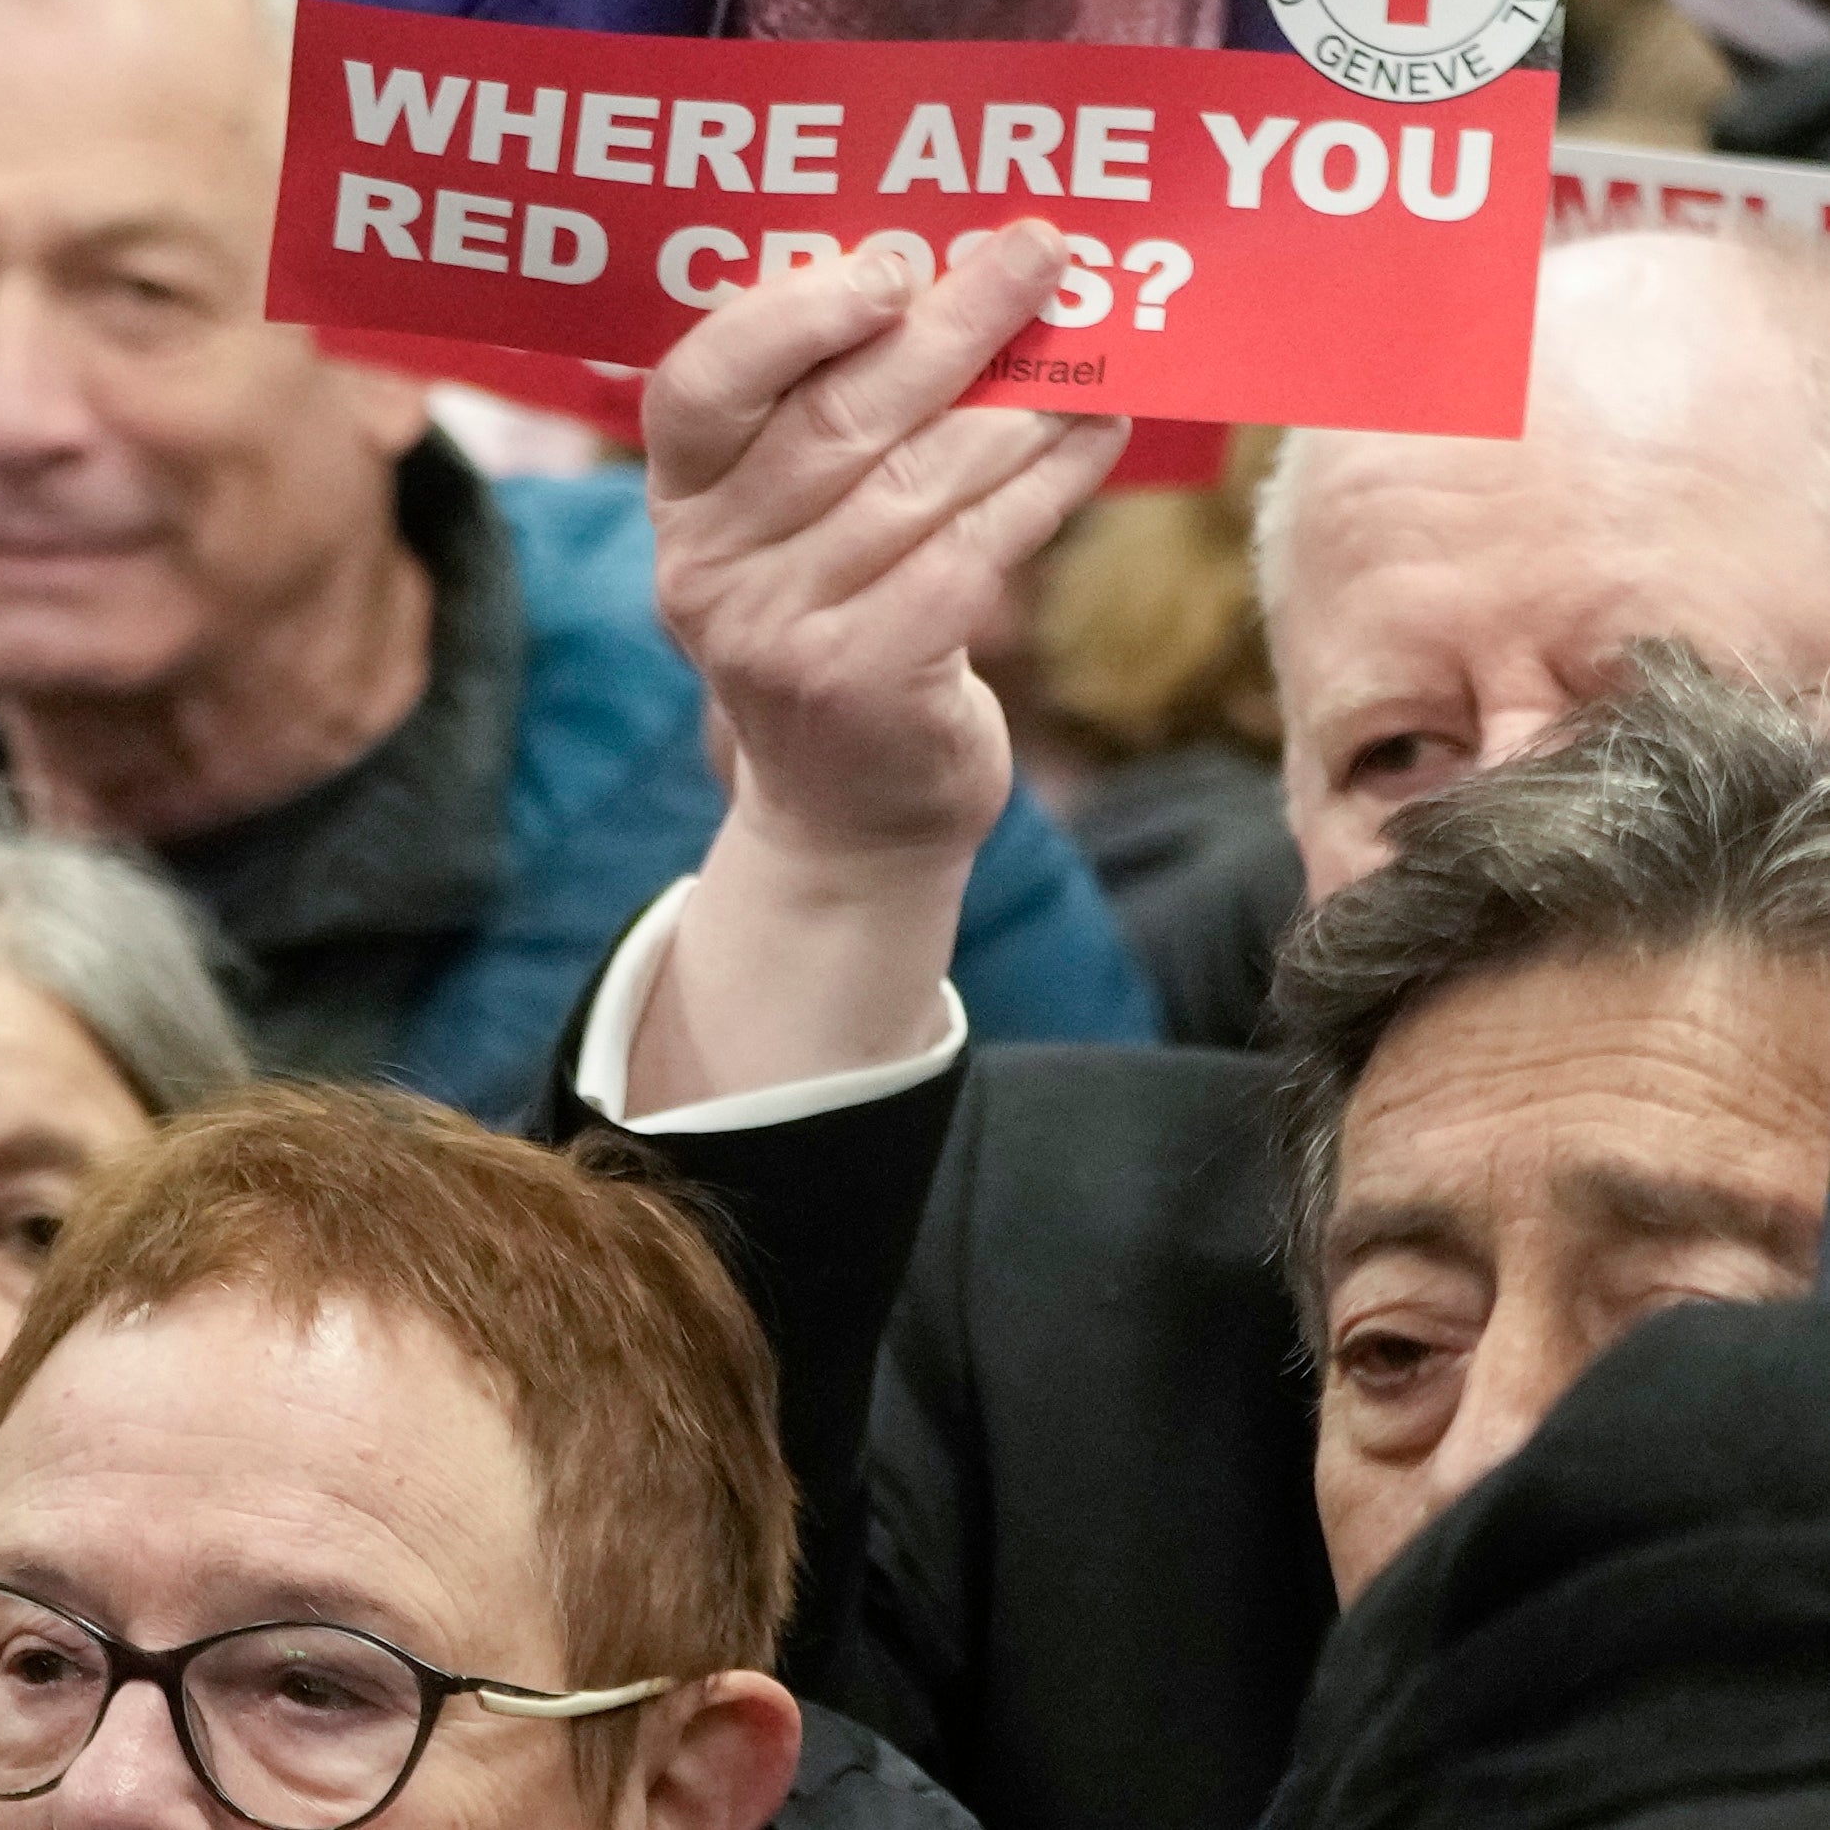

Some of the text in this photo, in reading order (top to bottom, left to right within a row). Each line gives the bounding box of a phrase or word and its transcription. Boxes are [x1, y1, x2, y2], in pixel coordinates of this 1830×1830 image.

[1315, 34, 1495, 95] GENEVE
[337, 58, 1496, 224] WHERE ARE YOU
[332, 171, 611, 287] RED
